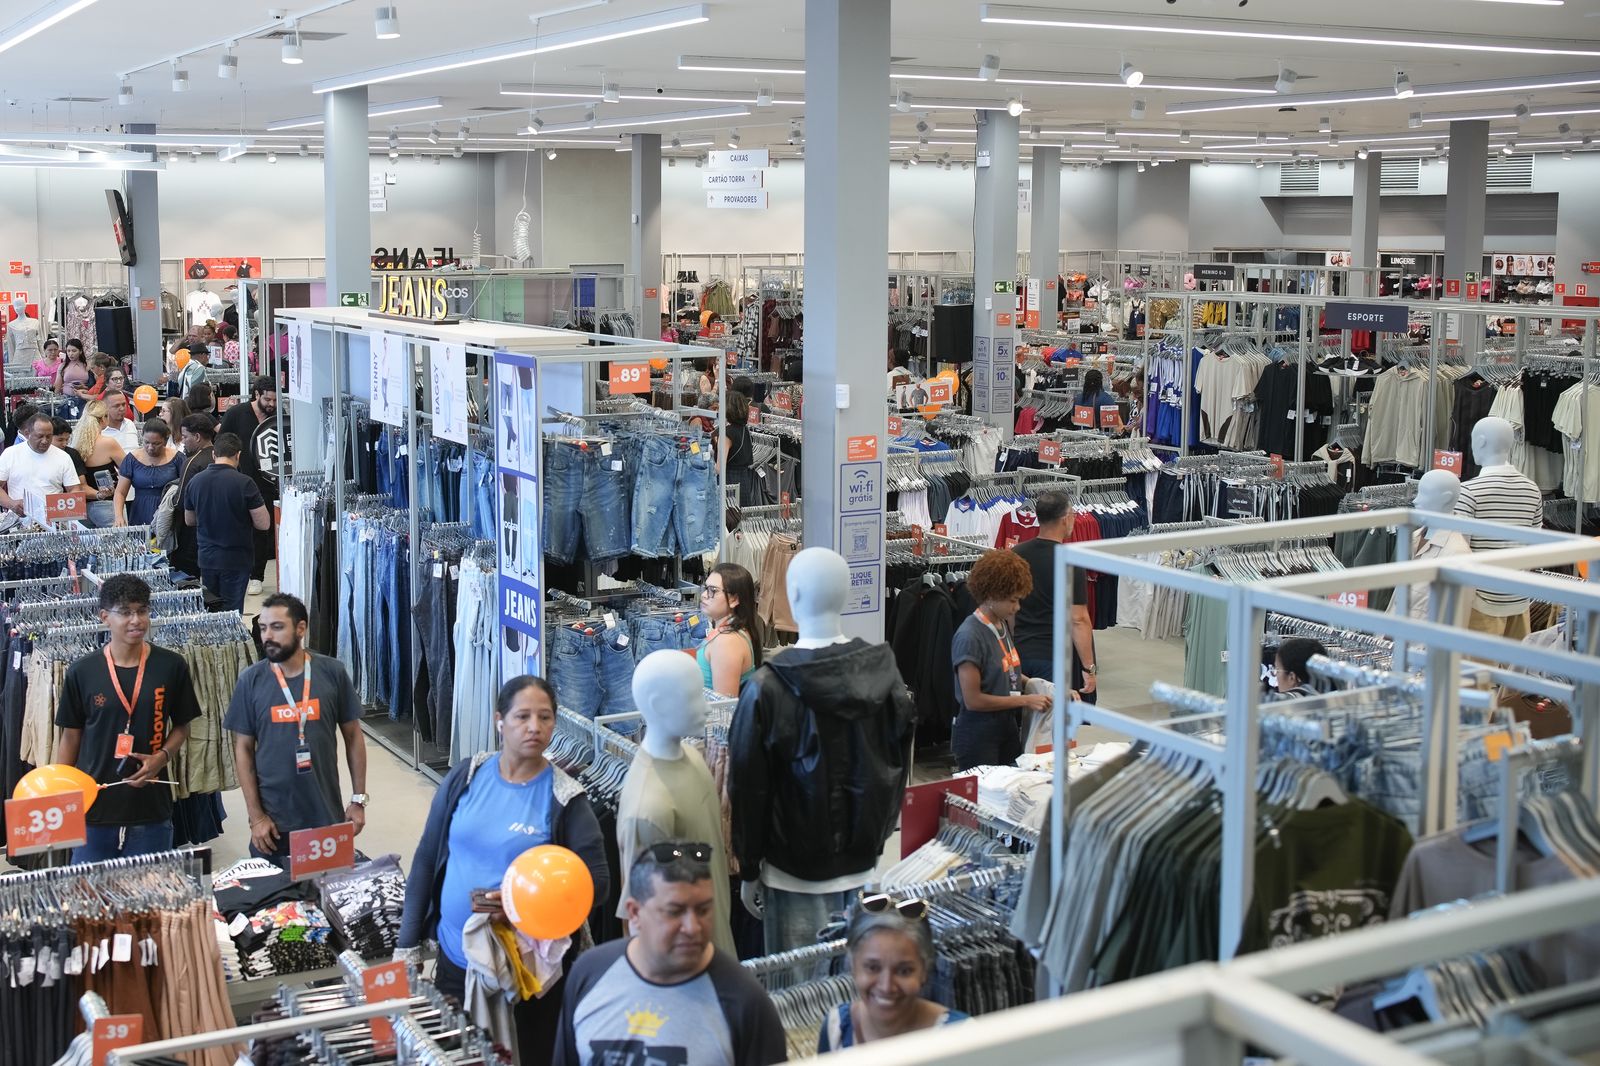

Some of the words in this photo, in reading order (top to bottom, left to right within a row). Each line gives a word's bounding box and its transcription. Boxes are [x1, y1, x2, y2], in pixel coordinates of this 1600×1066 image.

[730, 154, 749, 162] CAIXAS
[708, 173, 728, 184] CARTÃO
[729, 175, 746, 183] TORRA
[724, 195, 758, 203] PROVADORES
[1390, 257, 1416, 265] LINGERIE
[379, 273, 448, 320] JEANS
[1347, 312, 1384, 323] ESPORTE
[620, 368, 640, 383] 89
[433, 363, 441, 415] BAGGY
[934, 388, 945, 397] 29
[1079, 410, 1088, 419] 19
[1105, 414, 1114, 422] 19
[1044, 445, 1055, 456] 69
[1440, 455, 1454, 467] 89
[849, 480, 873, 493] wi-fi
[57, 497, 76, 511] 89
[848, 493, 873, 506] grátis
[851, 577, 873, 587] RETIRE
[504, 588, 537, 628] JEANS
[276, 705, 315, 719] TOA
[28, 807, 64, 833] 39
[308, 837, 337, 860] 39
[374, 970, 396, 987] 49
[106, 1024, 129, 1039] 39
